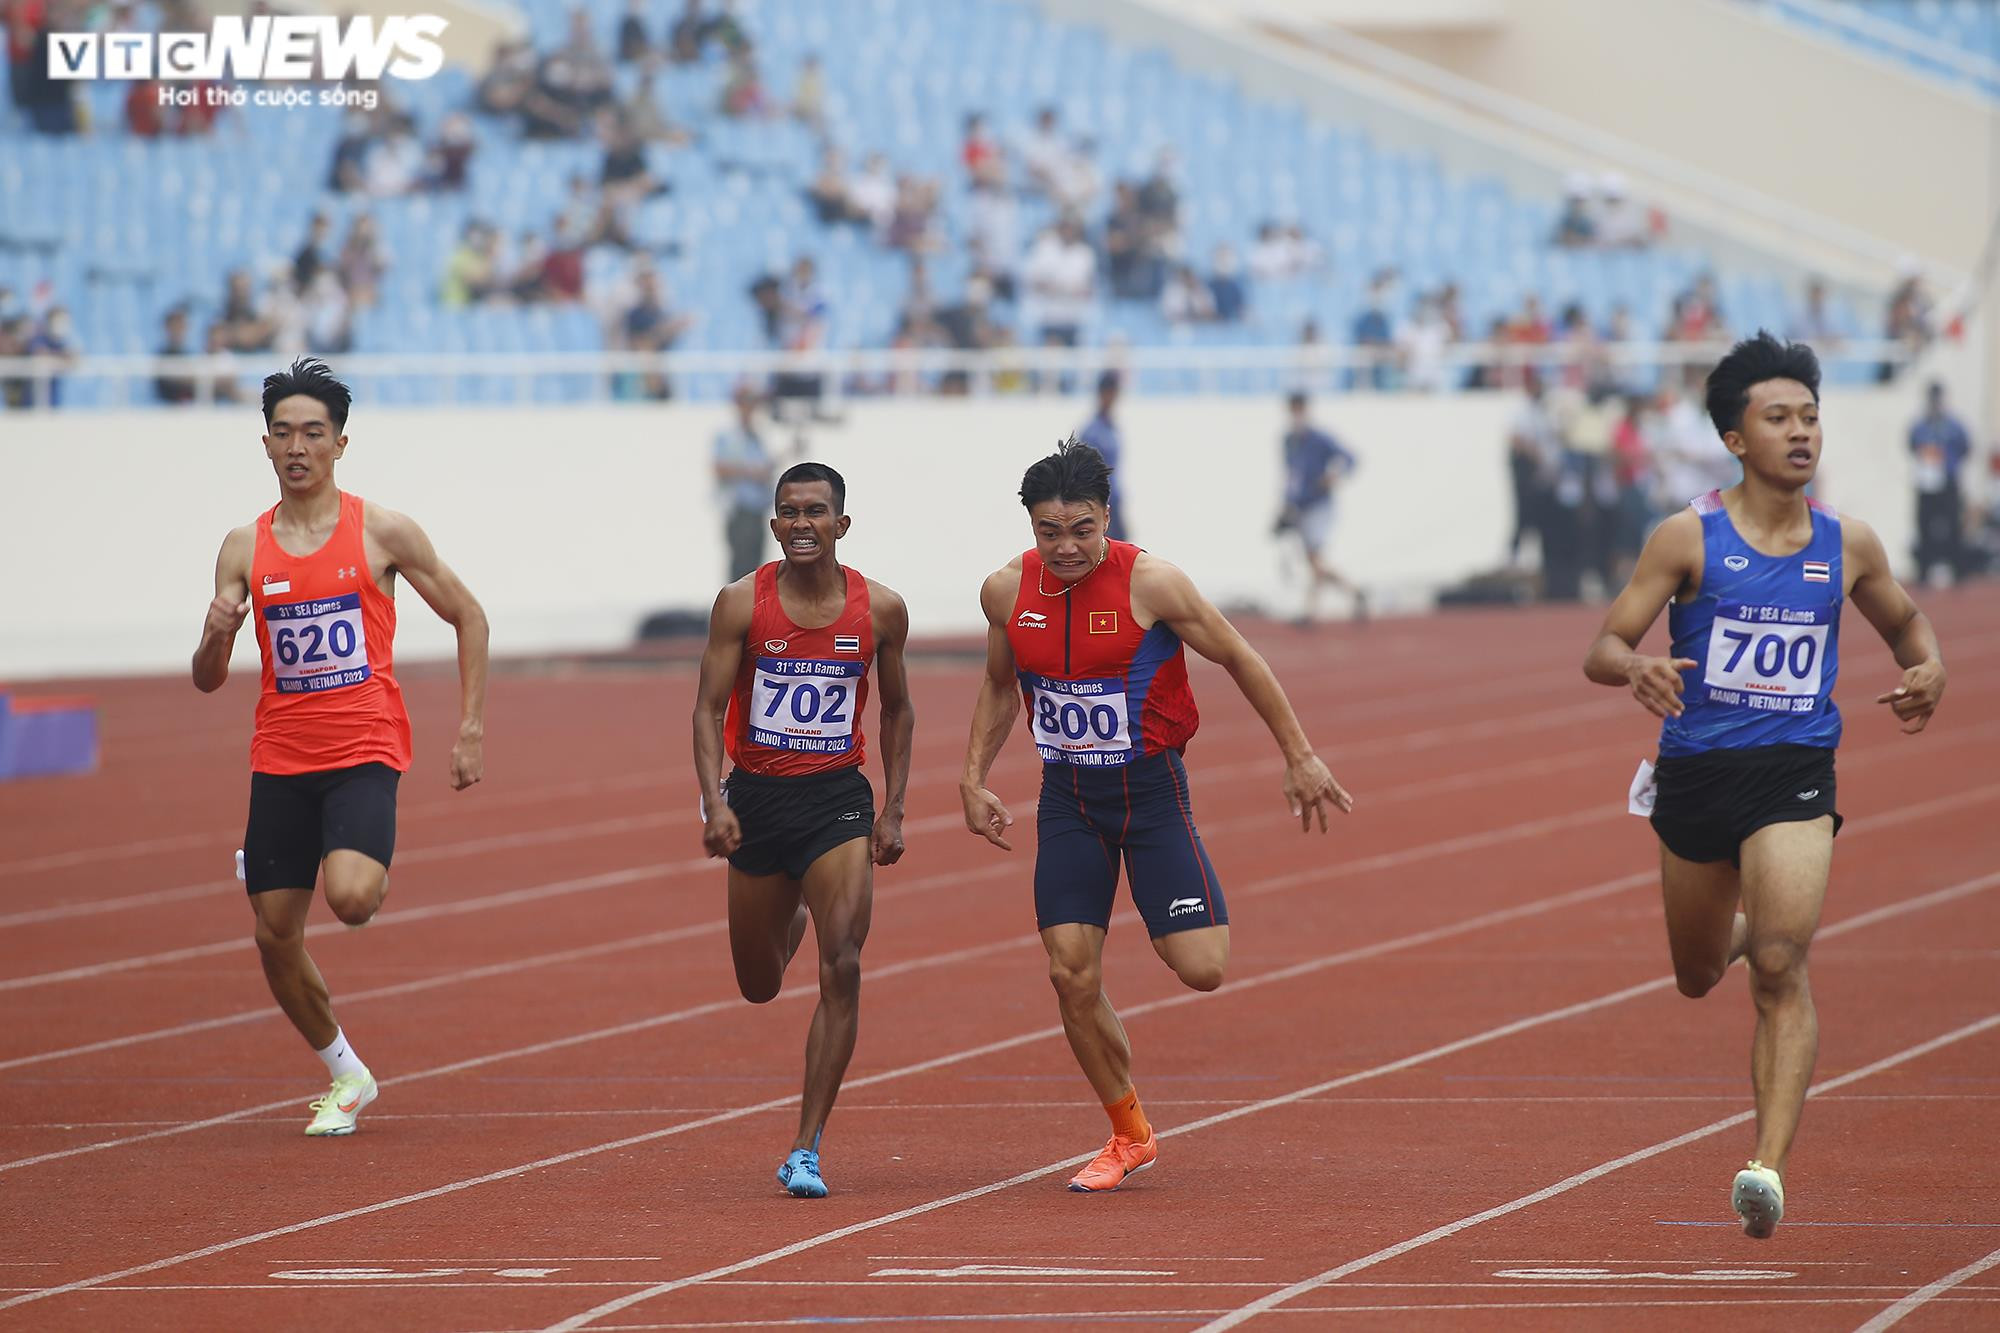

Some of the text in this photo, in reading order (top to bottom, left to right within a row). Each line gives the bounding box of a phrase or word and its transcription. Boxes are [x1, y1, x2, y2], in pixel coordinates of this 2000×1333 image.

[294, 604, 311, 616] SEA
[312, 601, 341, 615] Games
[1759, 607, 1779, 621] SEA
[276, 620, 356, 666] 620
[1723, 628, 1816, 679] 700
[794, 662, 812, 674] SEA
[814, 663, 845, 676] Games
[308, 673, 343, 689] VIETNAM
[344, 670, 364, 683] 2022
[1071, 683, 1103, 694] Games
[763, 678, 847, 723] 702
[1710, 688, 1740, 705] HANOI
[1748, 694, 1791, 711] VIETNAM
[1791, 697, 1815, 712] 2022
[1039, 696, 1119, 741] 800
[755, 731, 781, 747] HANOI
[788, 738, 825, 751] VIETNAM
[827, 738, 846, 751] 2022
[784, 727, 822, 736] THAILAND
[1067, 752, 1102, 765] VIETNAM
[1104, 752, 1125, 765] 2022
